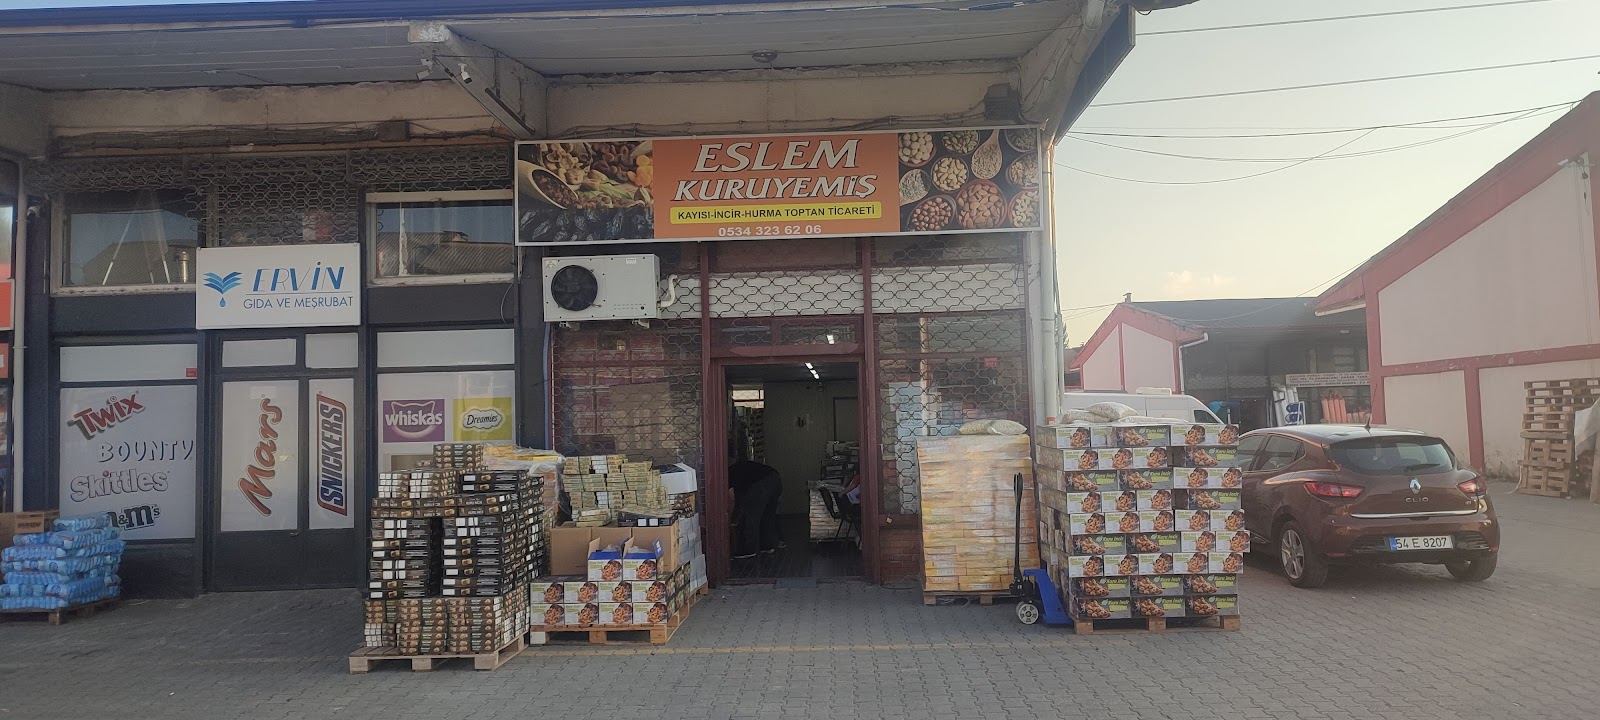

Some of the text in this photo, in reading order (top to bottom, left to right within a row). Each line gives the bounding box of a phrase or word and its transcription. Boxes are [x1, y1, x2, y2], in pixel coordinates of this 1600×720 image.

[693, 138, 861, 173] ESLEM
[671, 174, 878, 202] KURUYEMİŞ
[677, 204, 876, 221] KAYISI-İNCİR-HURMA TOPTAN TİCARETİ
[717, 224, 822, 237] 0534 323 62 06
[253, 262, 345, 292] ERVİN
[243, 296, 353, 310] GIDA VE MEŞRUBAT
[385, 409, 443, 427] whiskas
[467, 412, 500, 428] Dreamies
[98, 440, 194, 462] BOUNTY
[237, 397, 283, 518] Mars
[319, 402, 345, 508] SNICKERS
[70, 469, 168, 502] Skittles
[1396, 537, 1447, 549] 54 E 8207
